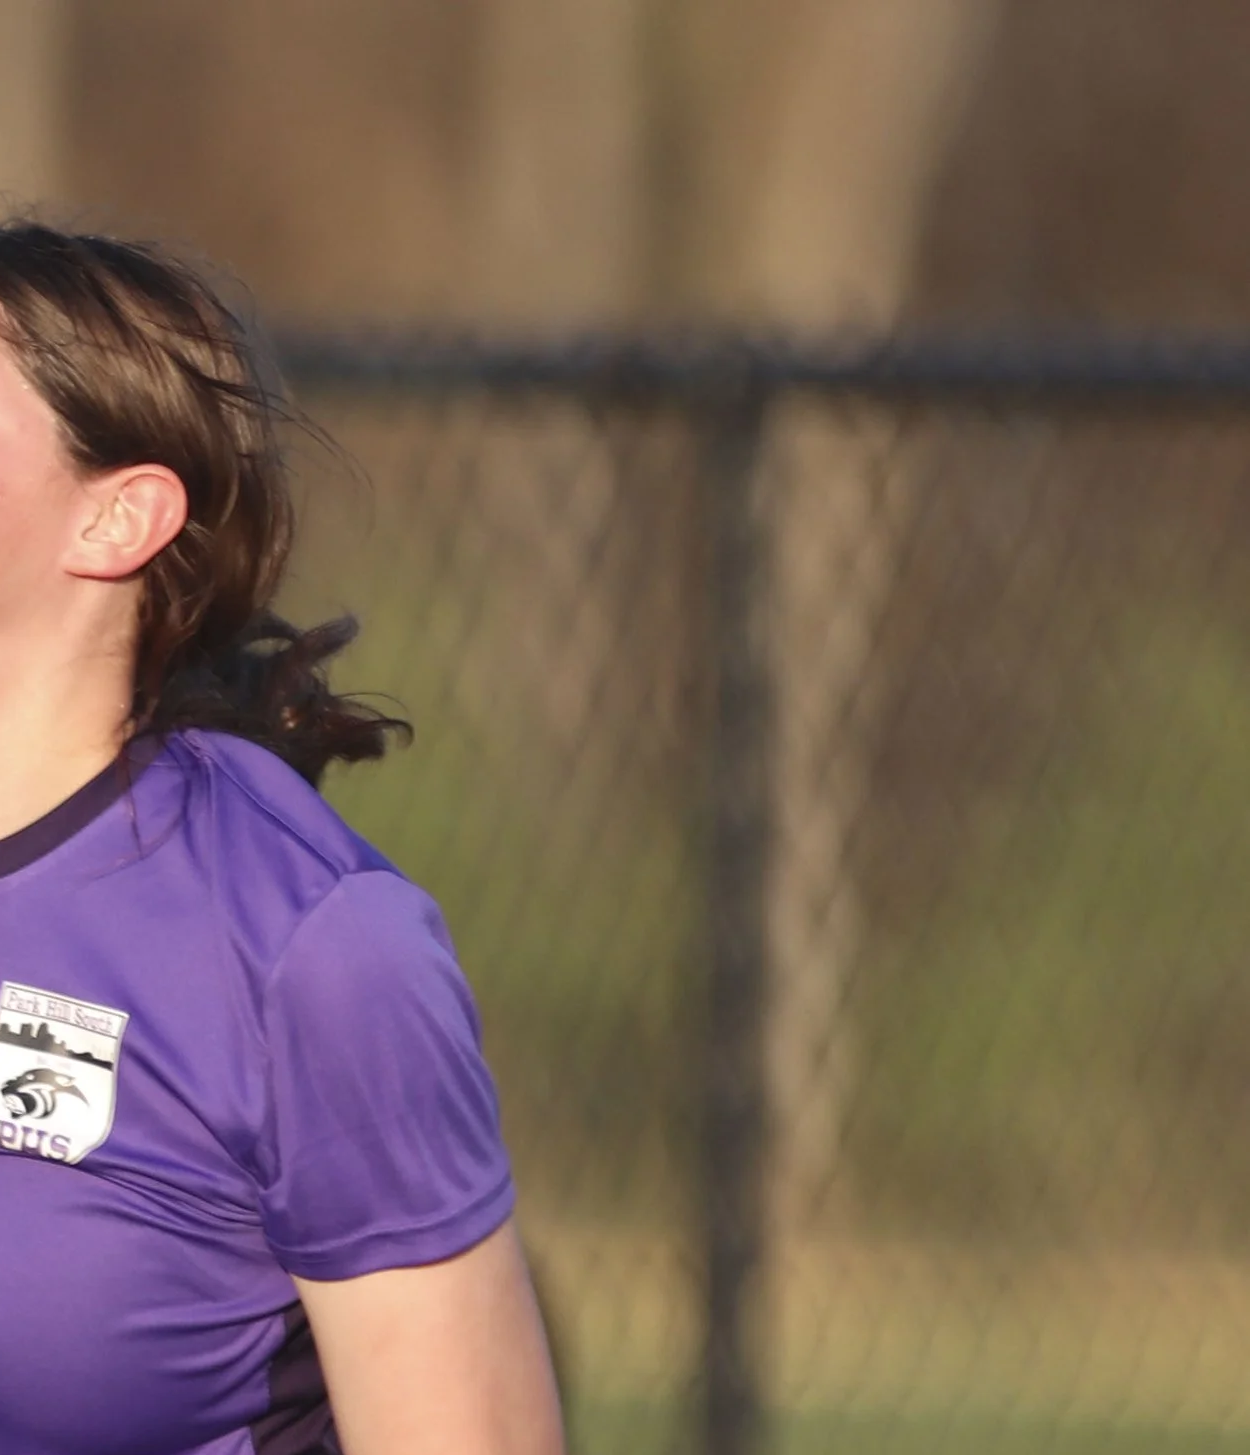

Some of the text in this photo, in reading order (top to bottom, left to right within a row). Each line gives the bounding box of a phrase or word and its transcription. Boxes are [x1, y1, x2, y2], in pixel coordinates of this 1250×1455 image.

[6, 990, 114, 1034] Park Hill South
